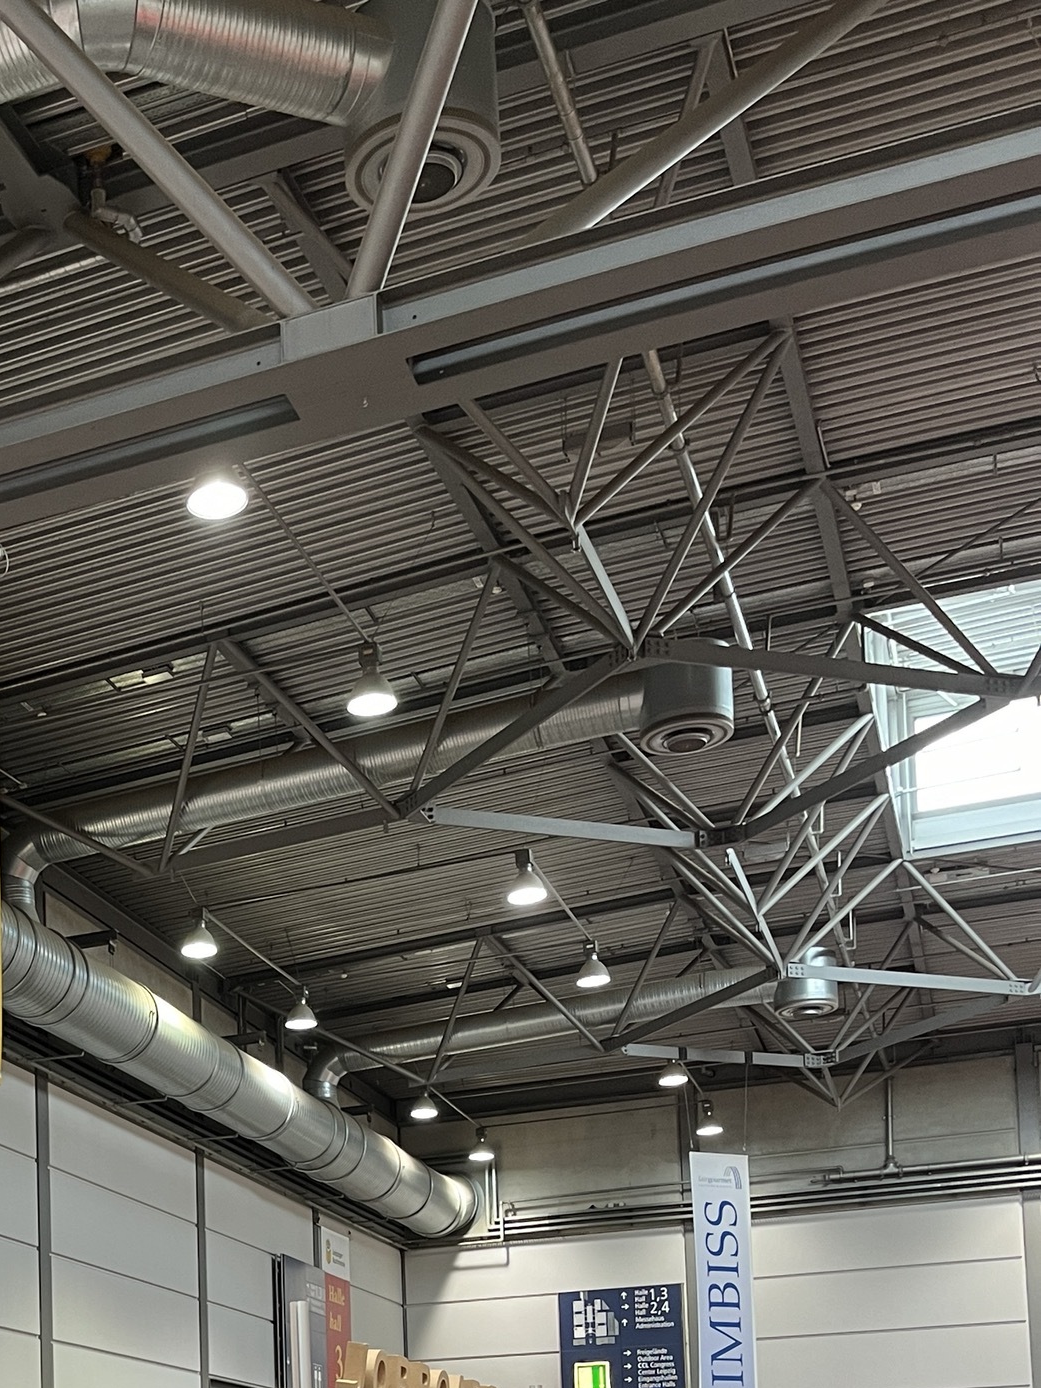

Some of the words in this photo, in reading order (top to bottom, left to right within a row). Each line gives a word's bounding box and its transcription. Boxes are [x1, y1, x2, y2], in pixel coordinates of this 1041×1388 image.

[328, 1284, 345, 1306] Halle
[649, 1287, 668, 1302] 1,3
[704, 1200, 744, 1387] IMBISS
[650, 1301, 670, 1315] 2,4
[329, 1311, 342, 1332] hall
[335, 1345, 344, 1379] 3
